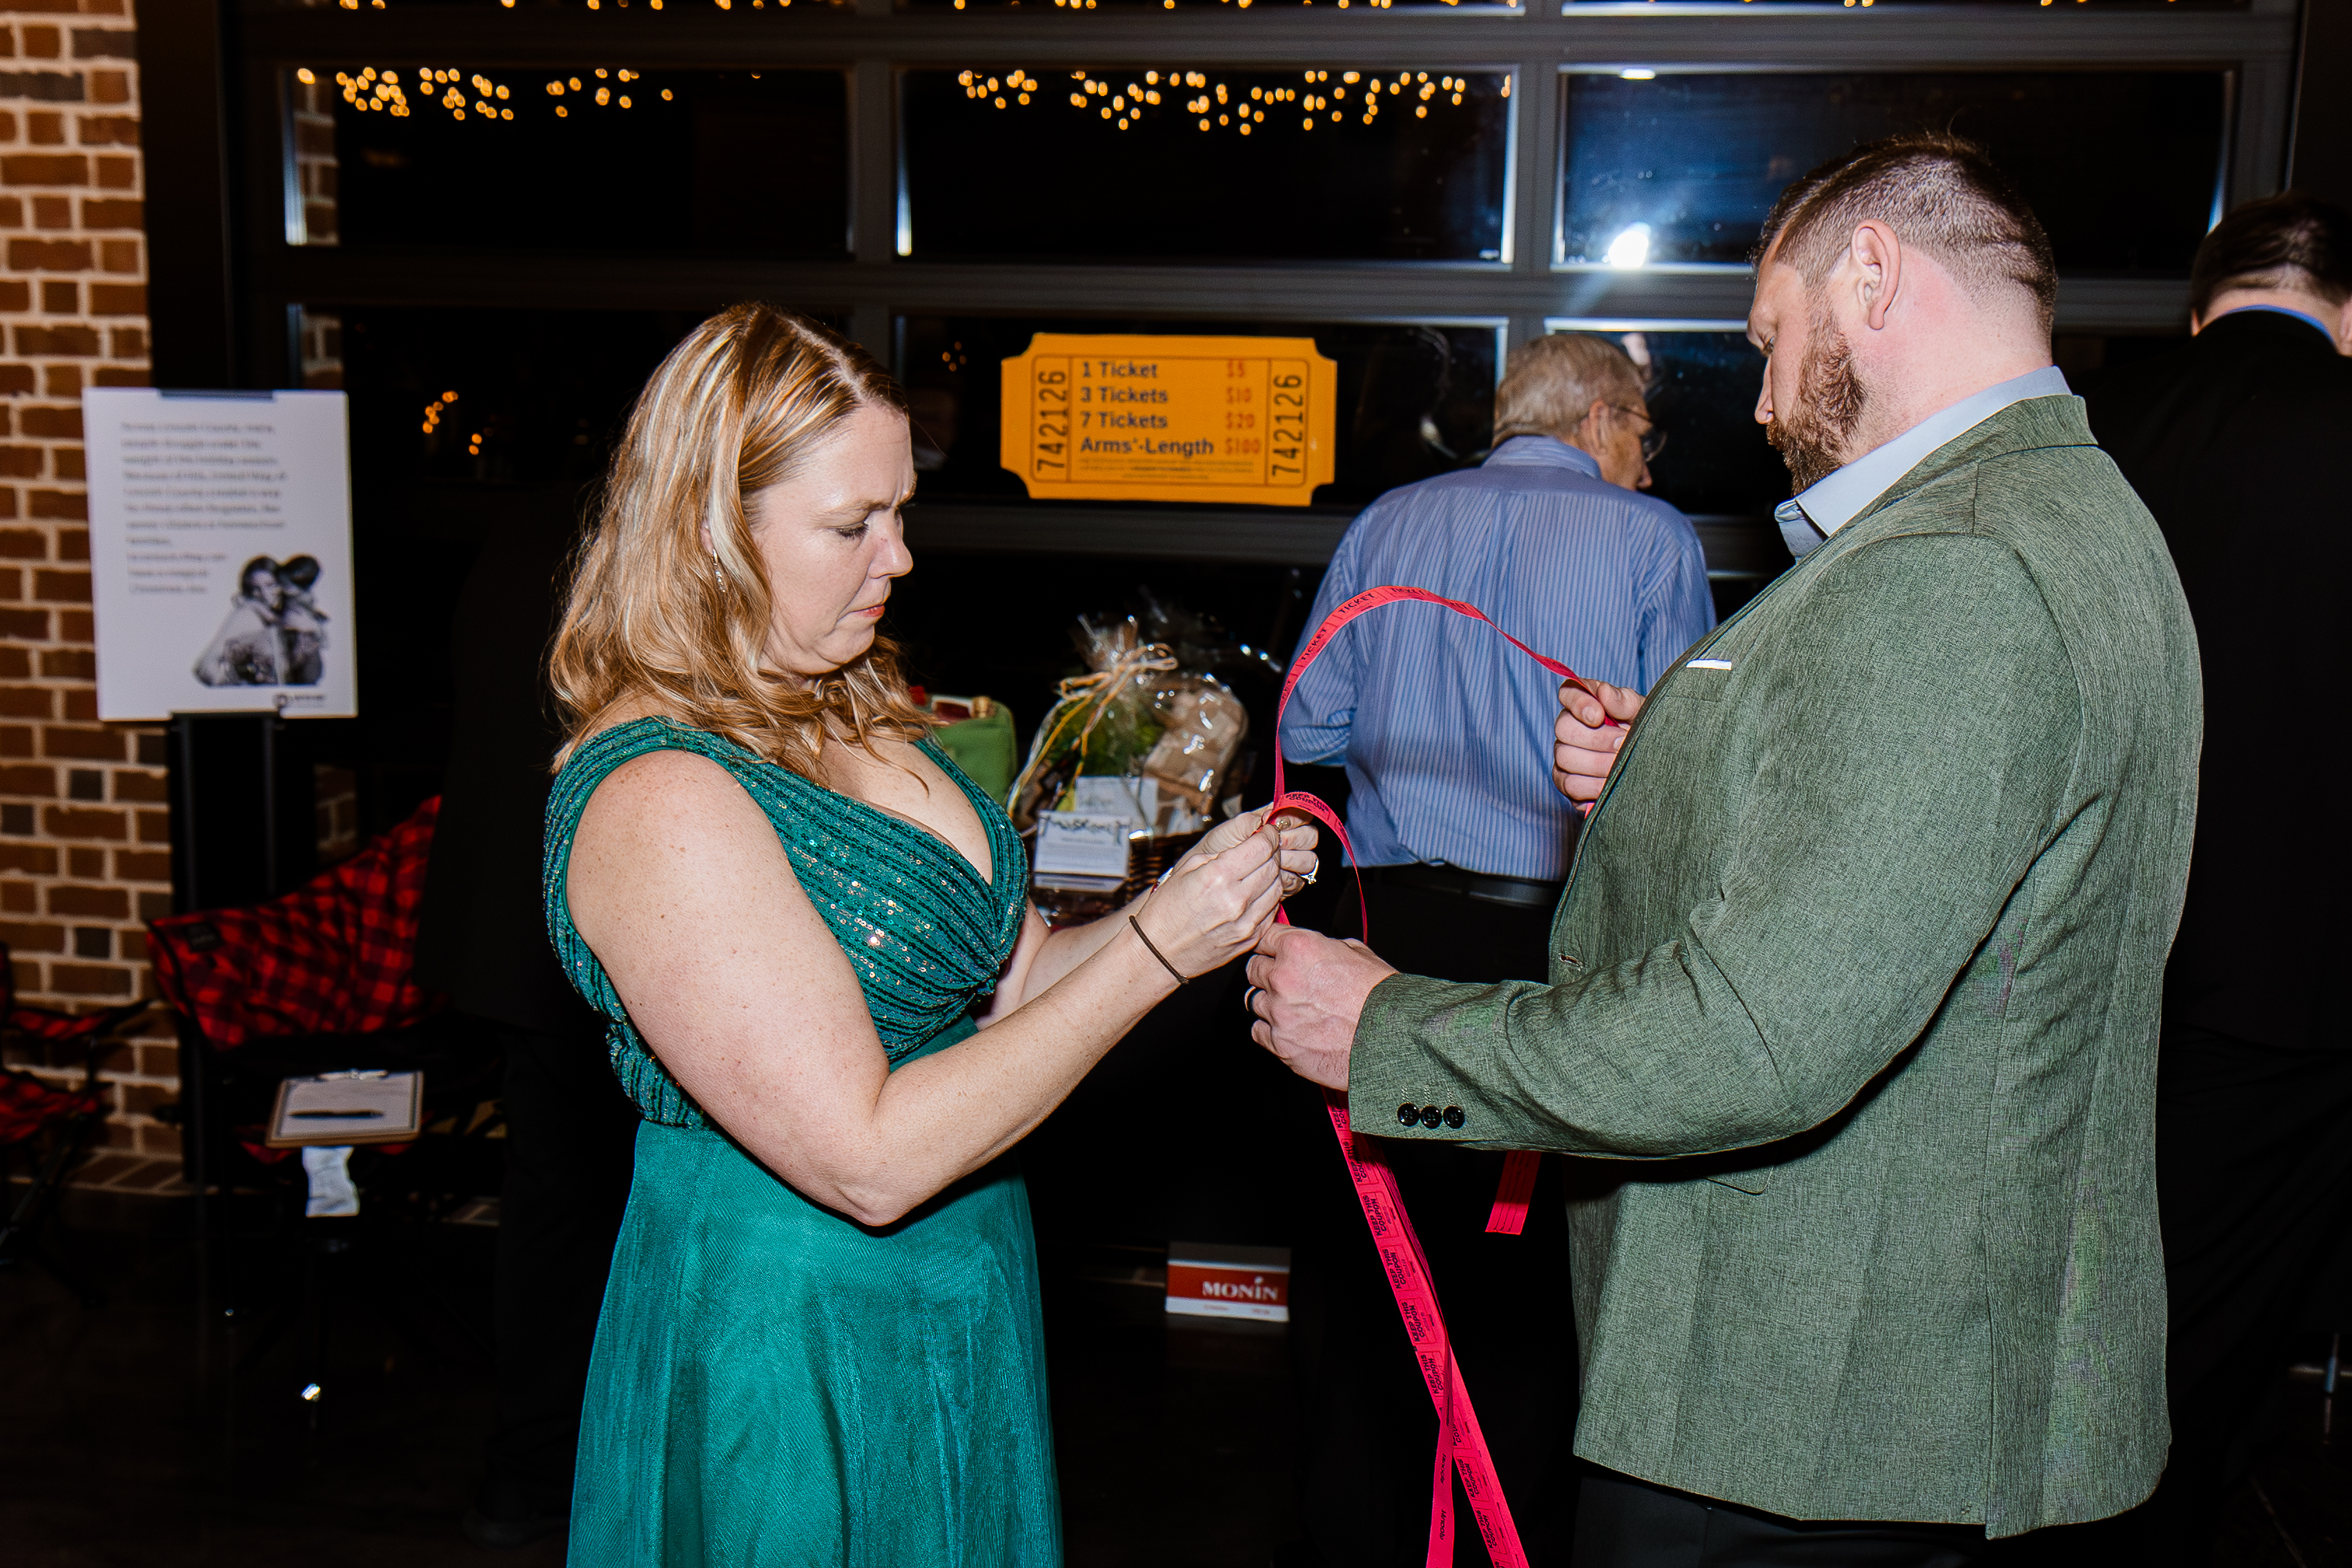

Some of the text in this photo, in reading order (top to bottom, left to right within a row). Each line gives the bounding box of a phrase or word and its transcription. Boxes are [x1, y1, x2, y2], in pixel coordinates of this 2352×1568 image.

[1083, 358, 1245, 378] 1 Ticket $5
[1081, 386, 1091, 402] 3
[1098, 386, 1168, 404] Tickets
[1037, 370, 1067, 473] 742126
[1081, 411, 1091, 428] 7
[1098, 411, 1168, 429] Tickets
[1273, 374, 1304, 476] 742126
[1339, 593, 1375, 614] TICKET
[1301, 627, 1326, 660] TICKET
[1363, 1195, 1382, 1236] KEEP THIS
[1371, 1198, 1387, 1232] COUPON
[1382, 1248, 1402, 1289] KEEP THIS
[1391, 1252, 1407, 1285] COUPON
[1402, 1302, 1420, 1342] KEEP THIS
[1409, 1305, 1425, 1338] COUPON
[1421, 1354, 1440, 1394] KEEP THIS
